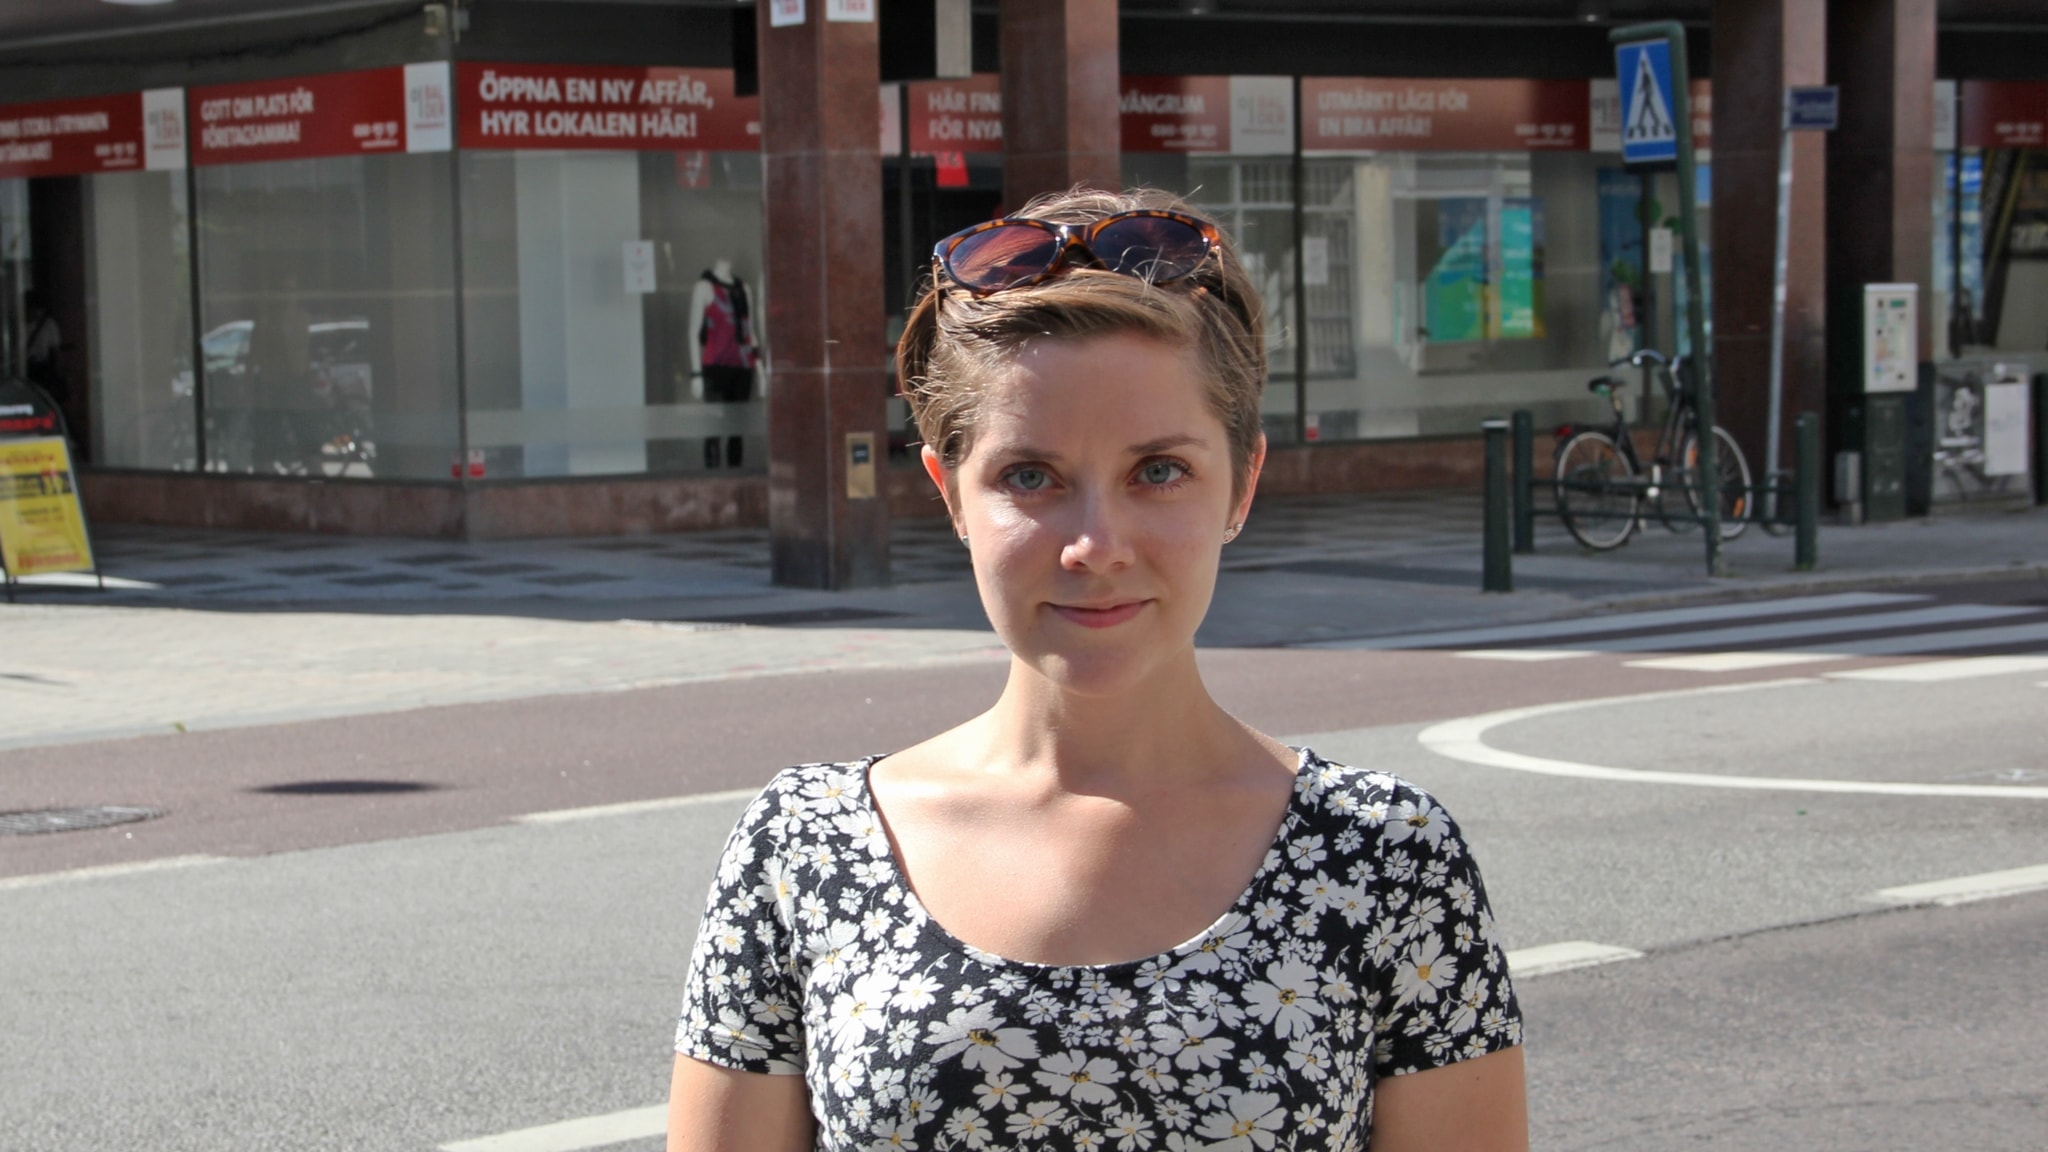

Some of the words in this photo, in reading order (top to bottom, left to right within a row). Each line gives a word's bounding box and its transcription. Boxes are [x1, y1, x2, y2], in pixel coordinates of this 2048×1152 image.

[479, 70, 561, 102] ÖPPNA
[566, 77, 597, 103] EN
[602, 79, 635, 104] NY
[639, 75, 714, 109] AFFÄR,
[928, 87, 967, 113] HÄR
[1318, 86, 1394, 111] UTMÄRKT
[1397, 86, 1435, 111] LÄGE
[1438, 87, 1469, 111] FÖR
[200, 99, 231, 121] GOTT
[232, 97, 253, 119] OM
[255, 93, 289, 116] PLATS
[289, 86, 314, 114] FÖR
[481, 110, 530, 135] HYR
[535, 111, 637, 137] LOKALEN
[641, 108, 697, 137] HÄR!
[929, 114, 965, 140] FÖR
[1319, 116, 1341, 137] EN
[1343, 115, 1376, 137] BRA
[1379, 112, 1432, 137] AFFÄR!
